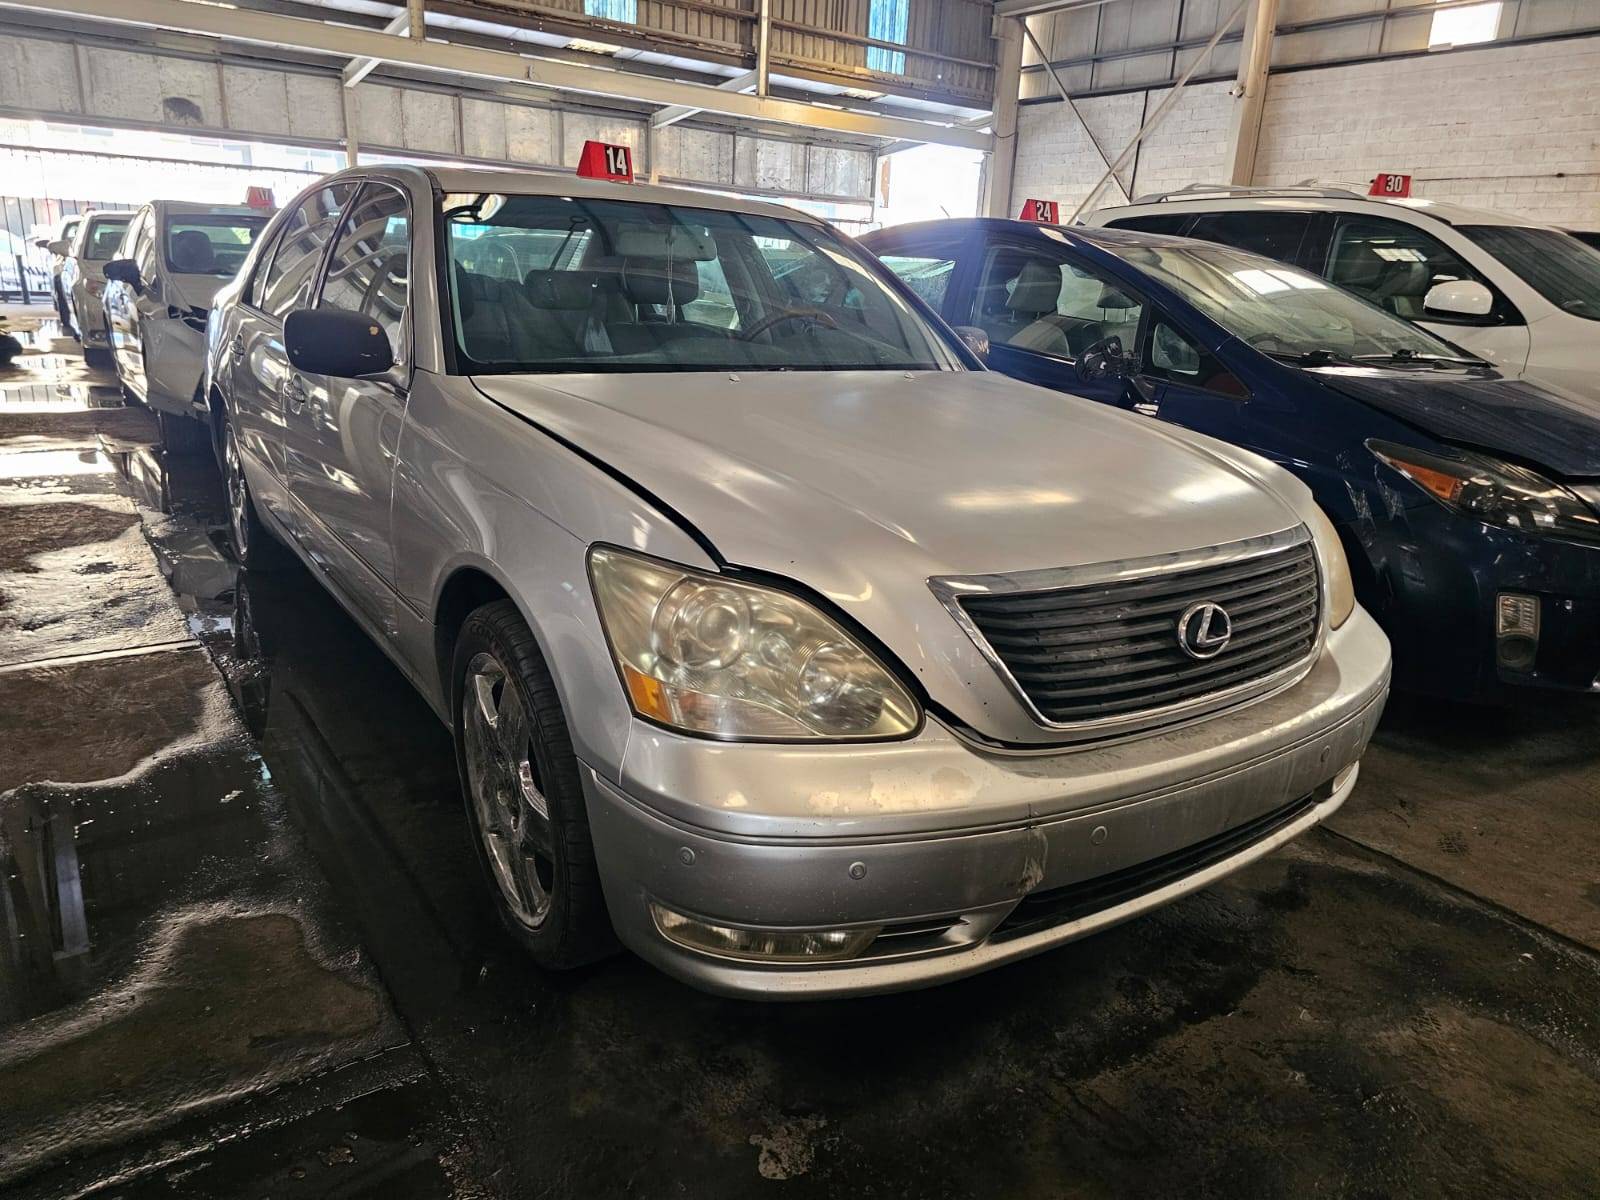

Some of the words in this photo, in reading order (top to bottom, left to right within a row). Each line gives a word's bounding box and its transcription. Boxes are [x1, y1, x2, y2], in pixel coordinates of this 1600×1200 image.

[606, 146, 628, 176] 14
[1386, 175, 1403, 192] 30
[1036, 201, 1052, 222] 24
